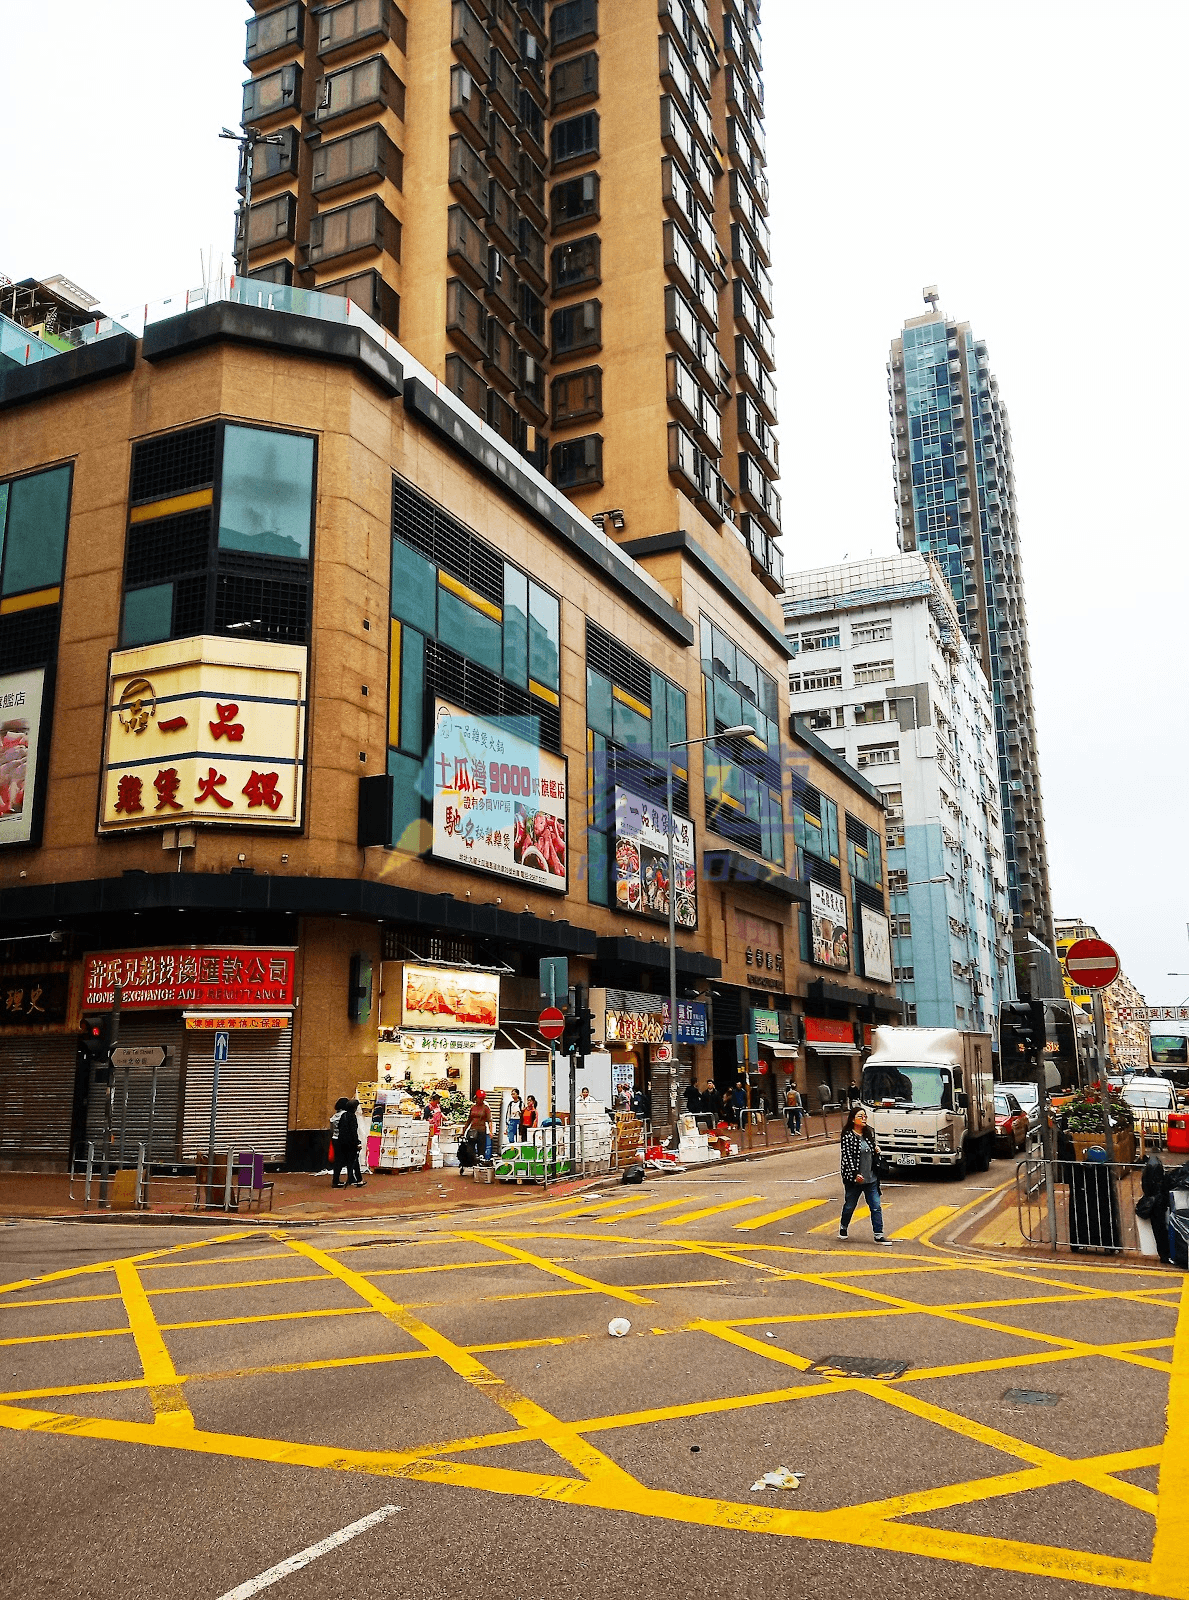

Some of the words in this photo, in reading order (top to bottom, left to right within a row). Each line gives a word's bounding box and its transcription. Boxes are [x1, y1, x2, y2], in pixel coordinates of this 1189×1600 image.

[0, 691, 26, 708] 艦店
[158, 702, 245, 741] 一品
[114, 767, 284, 814] 雞煲火鍋
[87, 991, 117, 1004] MONE
[122, 988, 175, 1003] EXCHANGE
